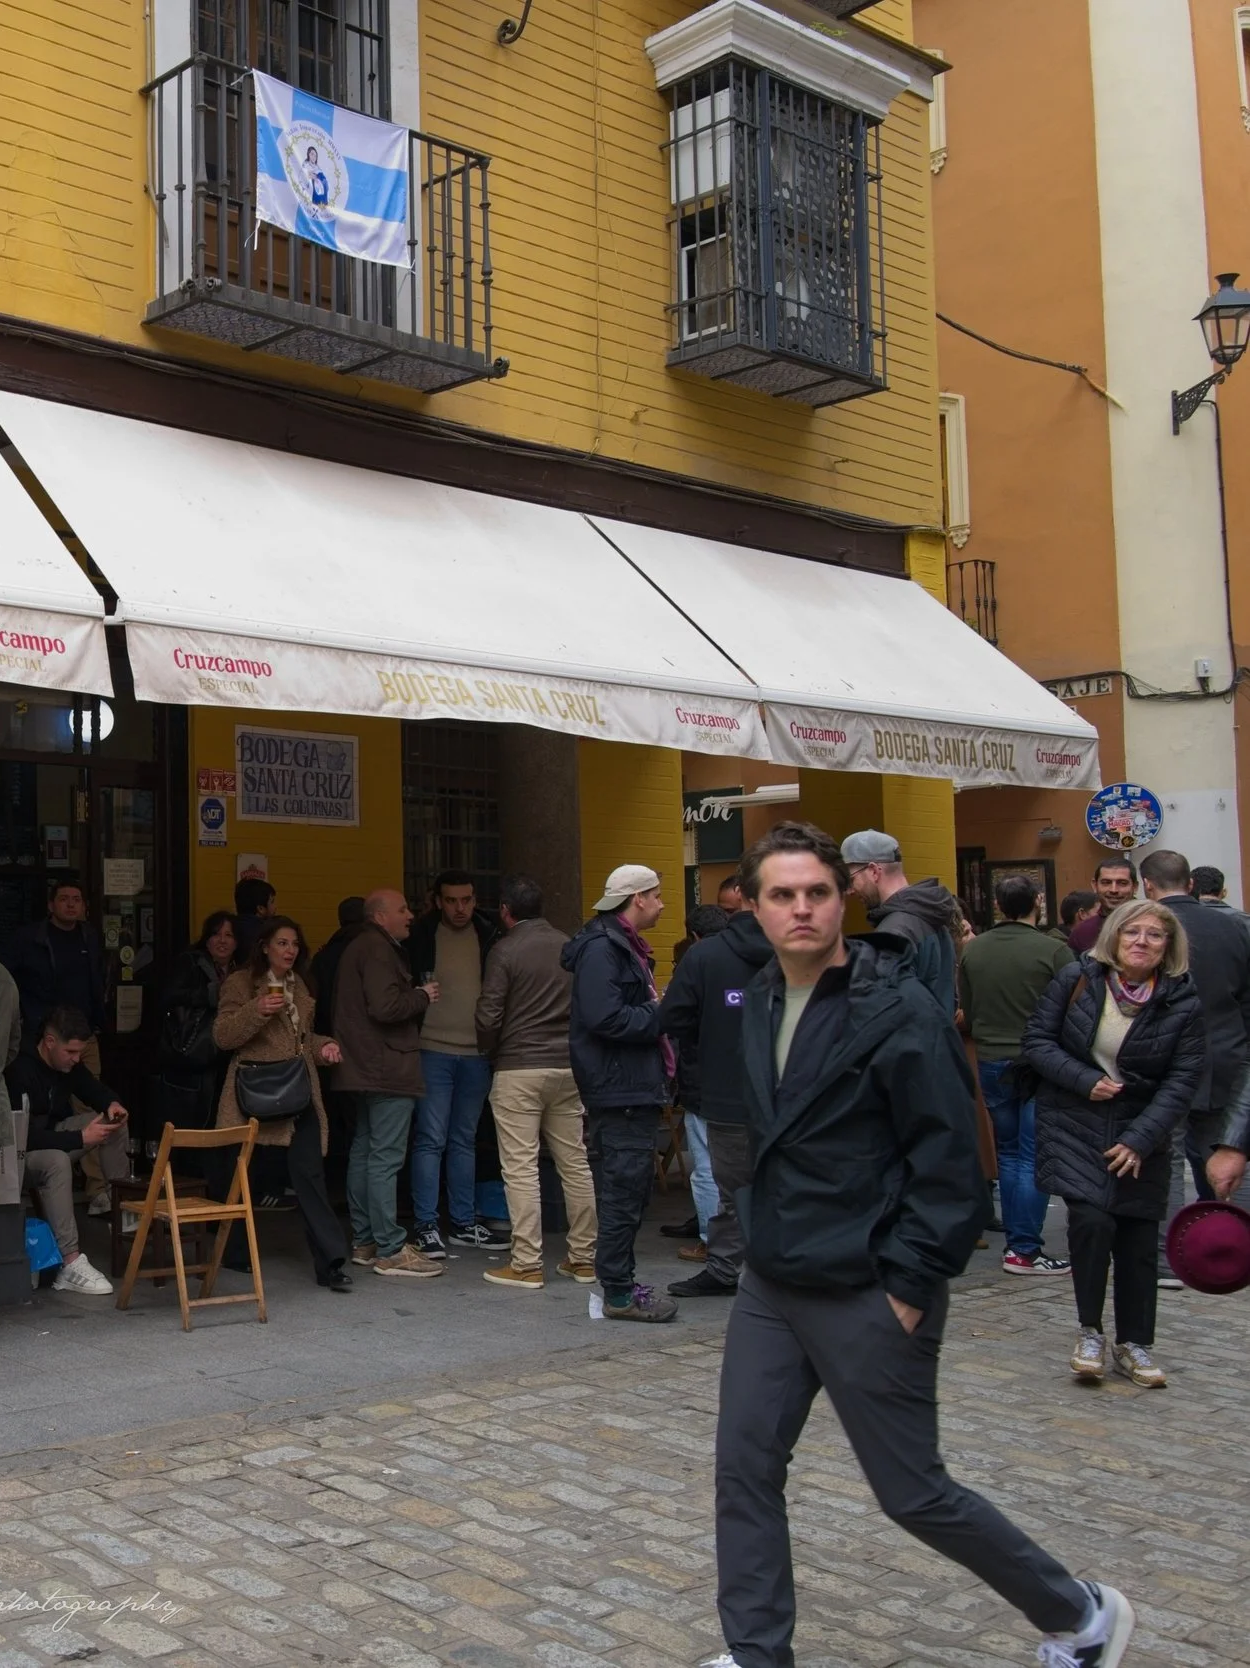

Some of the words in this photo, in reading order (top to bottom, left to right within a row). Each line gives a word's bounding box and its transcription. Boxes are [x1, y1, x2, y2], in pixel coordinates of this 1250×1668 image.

[173, 648, 272, 678] Cruzcampo
[198, 677, 259, 694] ESPECIAL
[377, 670, 478, 706] BODEGA
[474, 679, 551, 716] SANTA
[550, 690, 606, 726] CRUZ
[676, 707, 740, 732] Cruzcampo
[790, 721, 846, 745] Cruzcampo
[236, 734, 321, 769] BODEGA
[874, 729, 930, 764] BODEGA
[935, 737, 978, 768] SANTA
[982, 741, 1016, 772] CRUZ
[1036, 748, 1081, 768] Cruzcampo
[243, 766, 299, 796] SANTA
[302, 770, 352, 800] CRUZ
[255, 797, 278, 813] LAS
[283, 799, 343, 817] COLUMNAS
